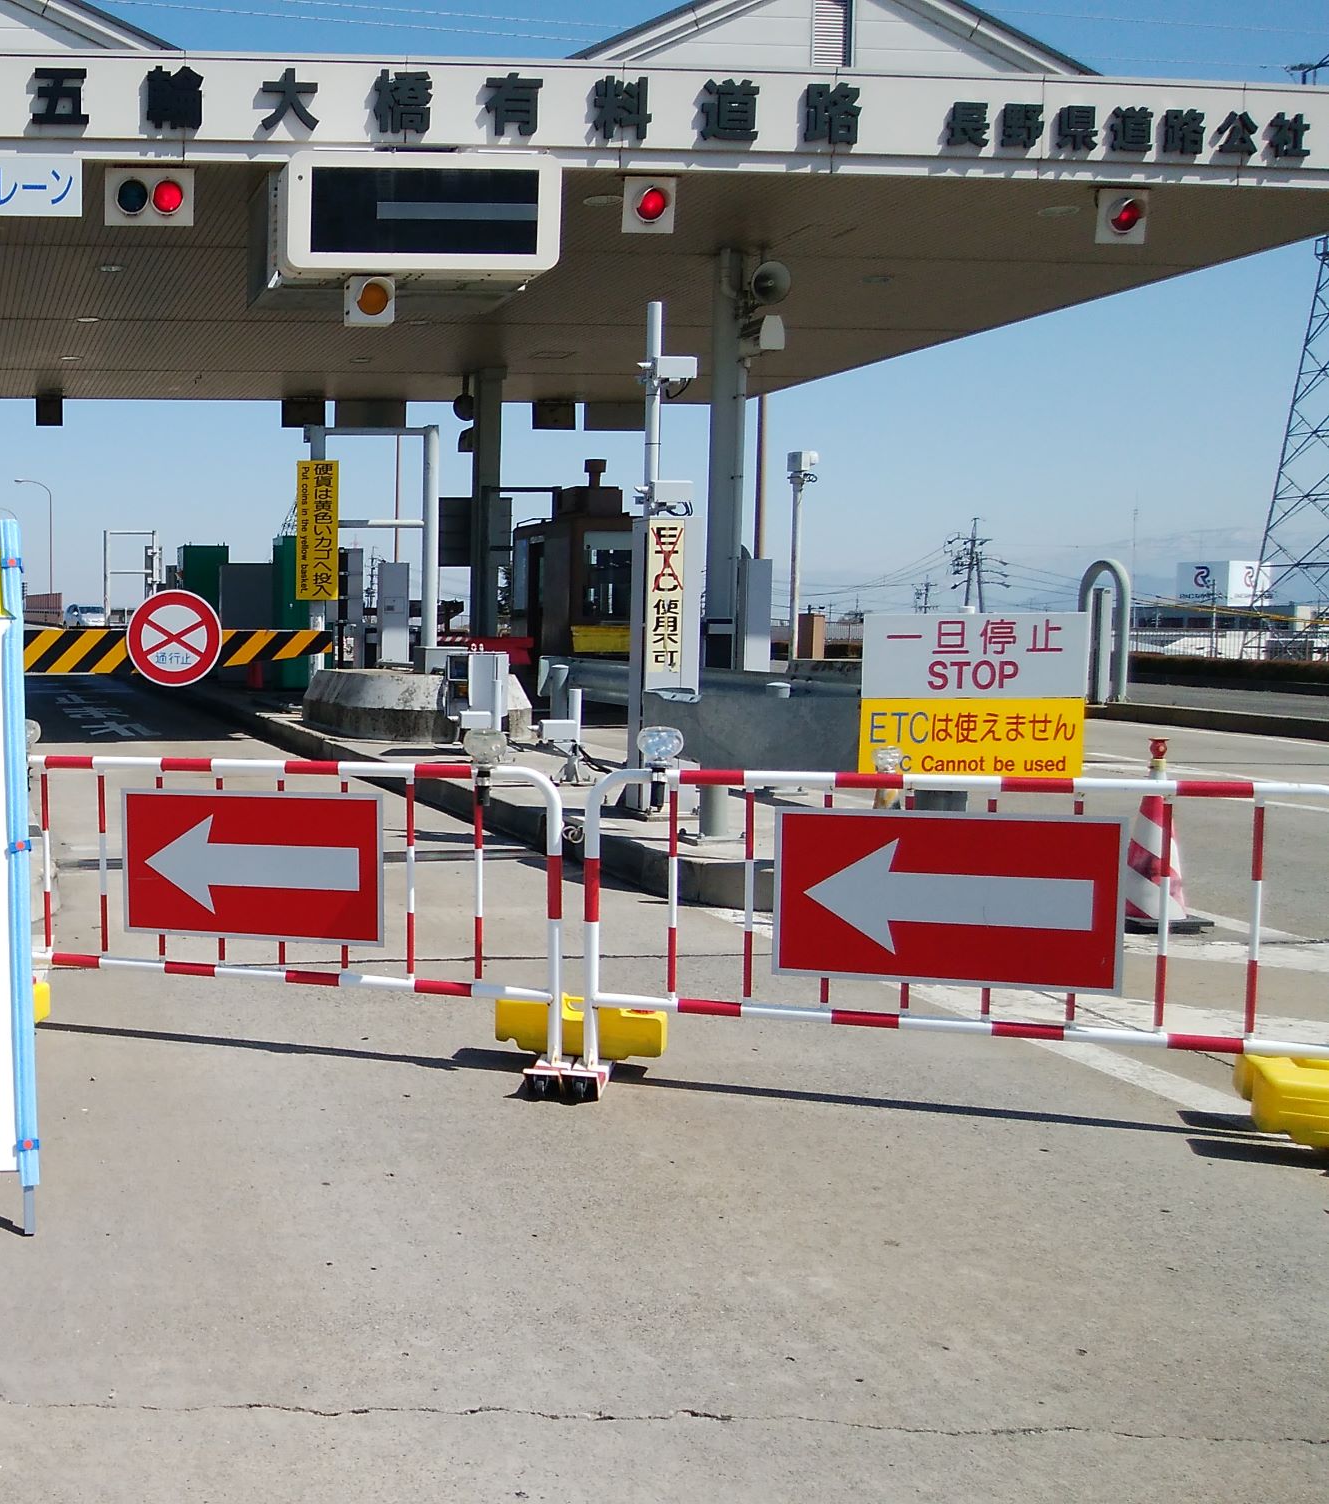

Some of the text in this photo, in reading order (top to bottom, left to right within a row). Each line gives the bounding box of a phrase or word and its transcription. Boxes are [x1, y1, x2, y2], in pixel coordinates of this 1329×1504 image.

[30, 66, 863, 147] 五輪大橋有料道路
[947, 101, 1312, 159] 長野県道路公社
[301, 466, 310, 480] Put
[301, 484, 309, 505] coins
[301, 508, 309, 516] in
[301, 518, 310, 532] the
[312, 463, 334, 597] 硬貨は黄色いカゴへ投入
[299, 535, 310, 560] yellow
[886, 618, 1064, 655] 一旦停止
[155, 652, 192, 665] 通行止
[927, 659, 1019, 690] STOP
[869, 711, 1077, 744] ETCは使えません
[921, 755, 986, 772] Cannot
[993, 755, 1016, 772] be
[1023, 755, 1067, 772] used
